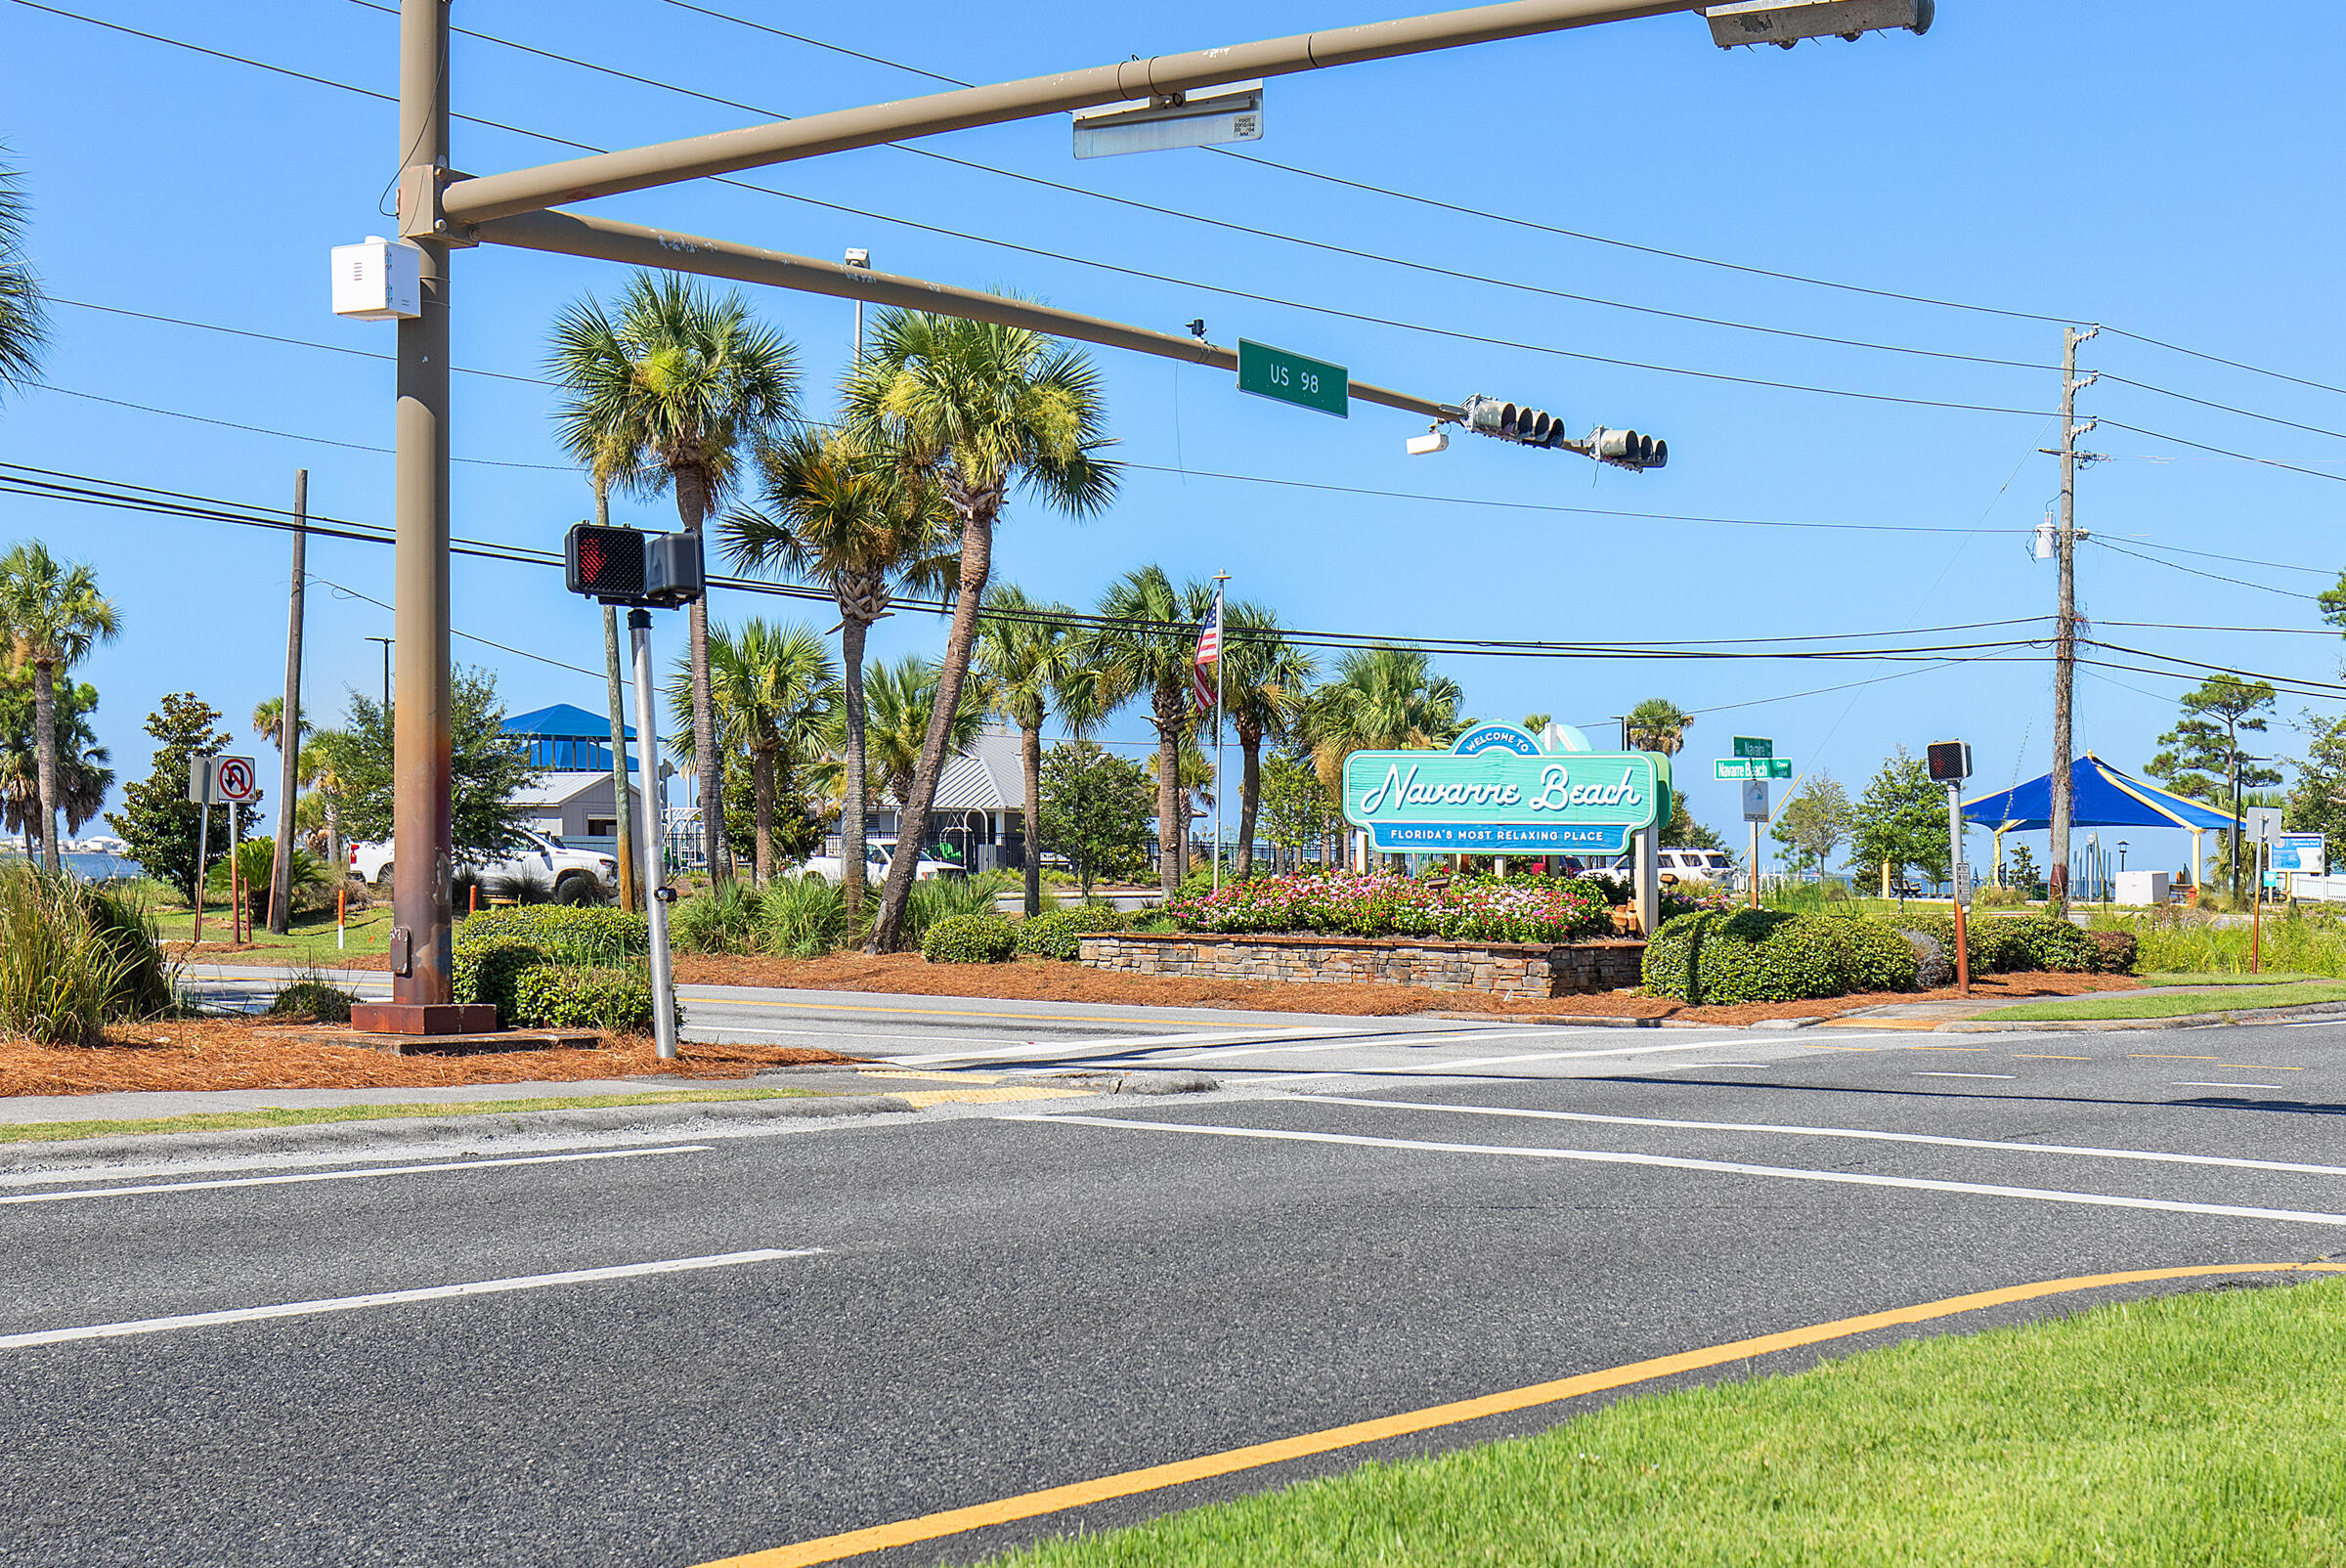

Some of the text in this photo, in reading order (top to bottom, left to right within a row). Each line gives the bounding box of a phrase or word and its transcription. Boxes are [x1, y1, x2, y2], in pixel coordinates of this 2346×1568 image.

[1271, 364, 1319, 393] US 98
[1466, 732, 1530, 752] WELCOME TO
[1718, 762, 1745, 777] Navarre
[1745, 762, 1767, 777] Beach
[1360, 763, 1642, 814] Navarre Beach
[1390, 829, 1604, 842] FLORIDA'S MOST RELAXING PLACE
